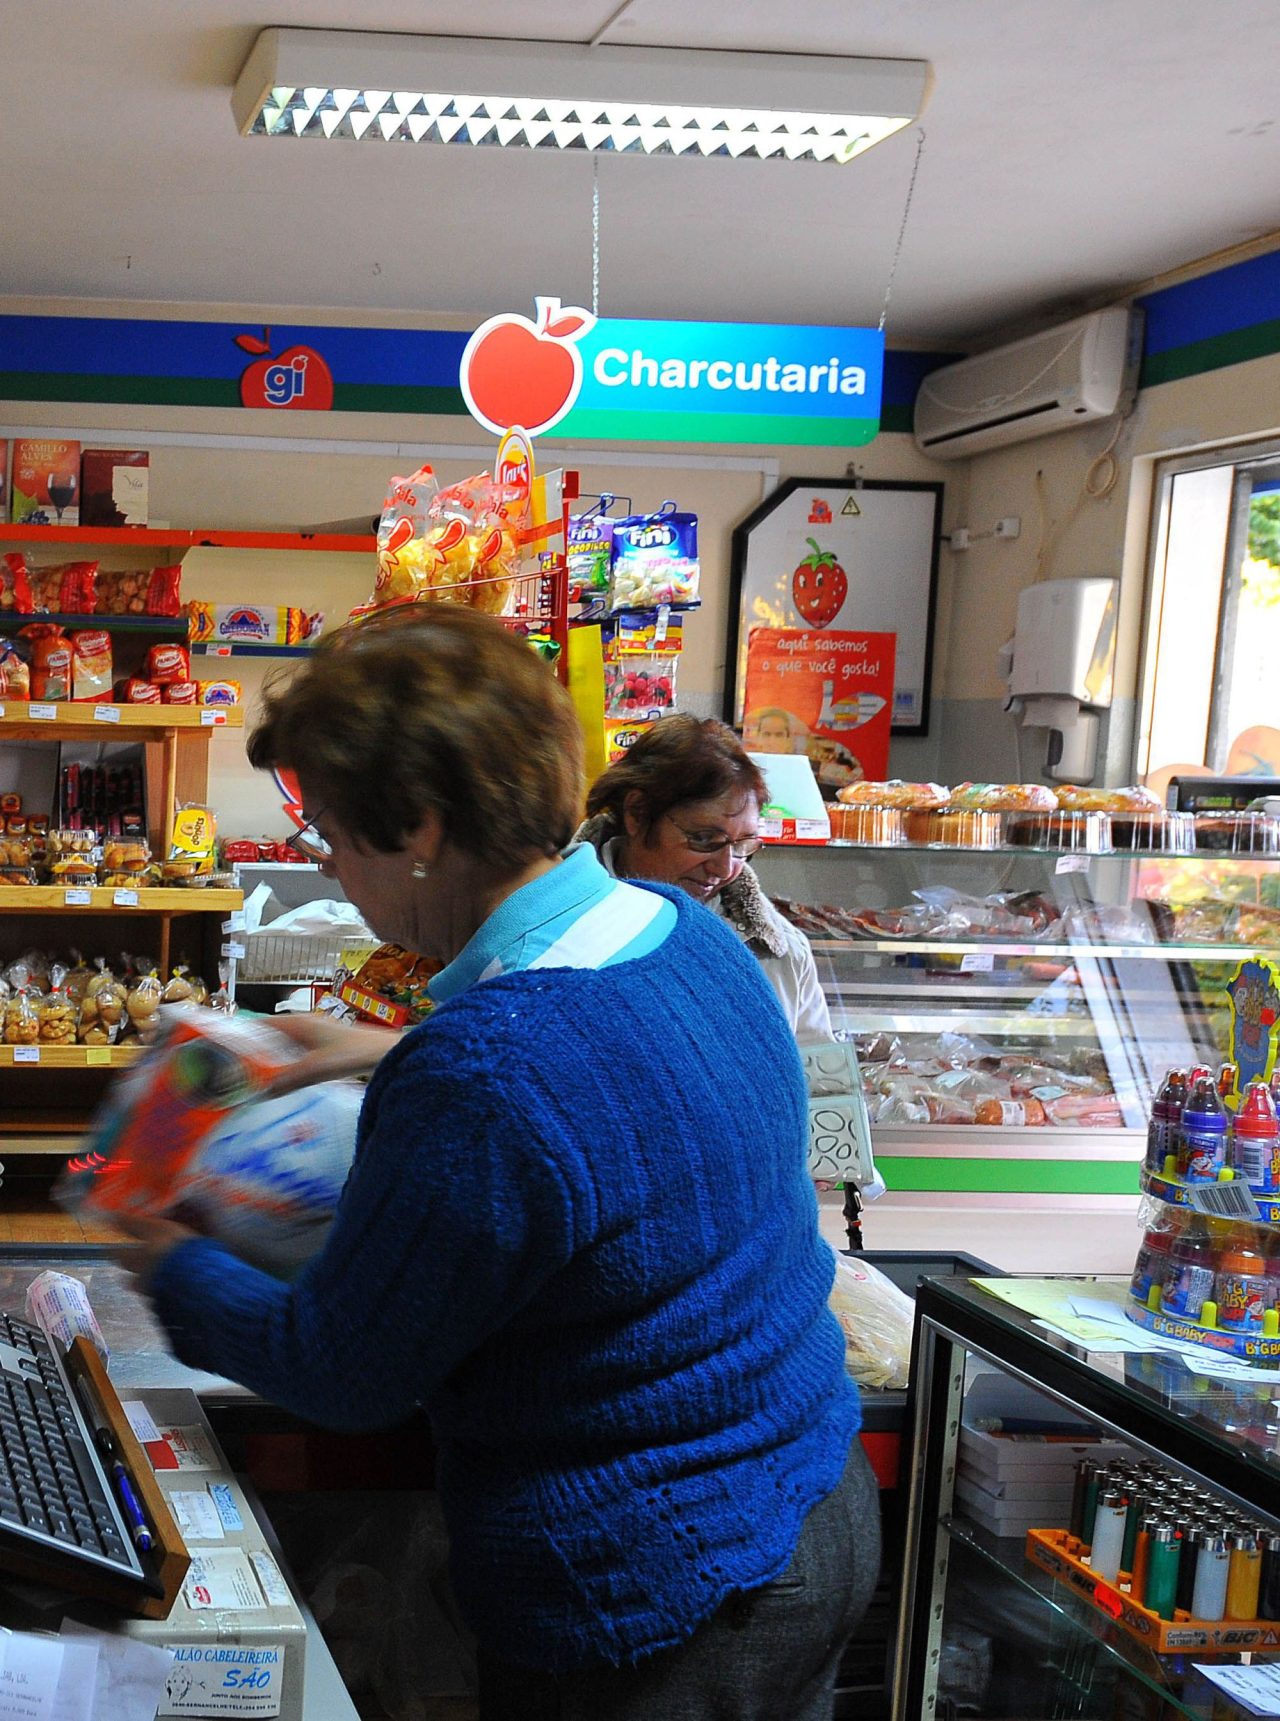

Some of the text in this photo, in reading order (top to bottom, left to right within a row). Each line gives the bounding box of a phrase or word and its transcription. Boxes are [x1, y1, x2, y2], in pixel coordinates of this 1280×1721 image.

[263, 356, 306, 406] gi
[593, 348, 867, 396] Charcutaria
[570, 525, 599, 541] Fini
[630, 526, 671, 548] Fini
[777, 634, 869, 654] aqui sabemos
[762, 658, 880, 681] o que você gosta!
[1174, 1325, 1207, 1343] BABY
[174, 1648, 279, 1665] ALÃO CABELEIREIRA
[223, 1667, 270, 1689] SÃO
